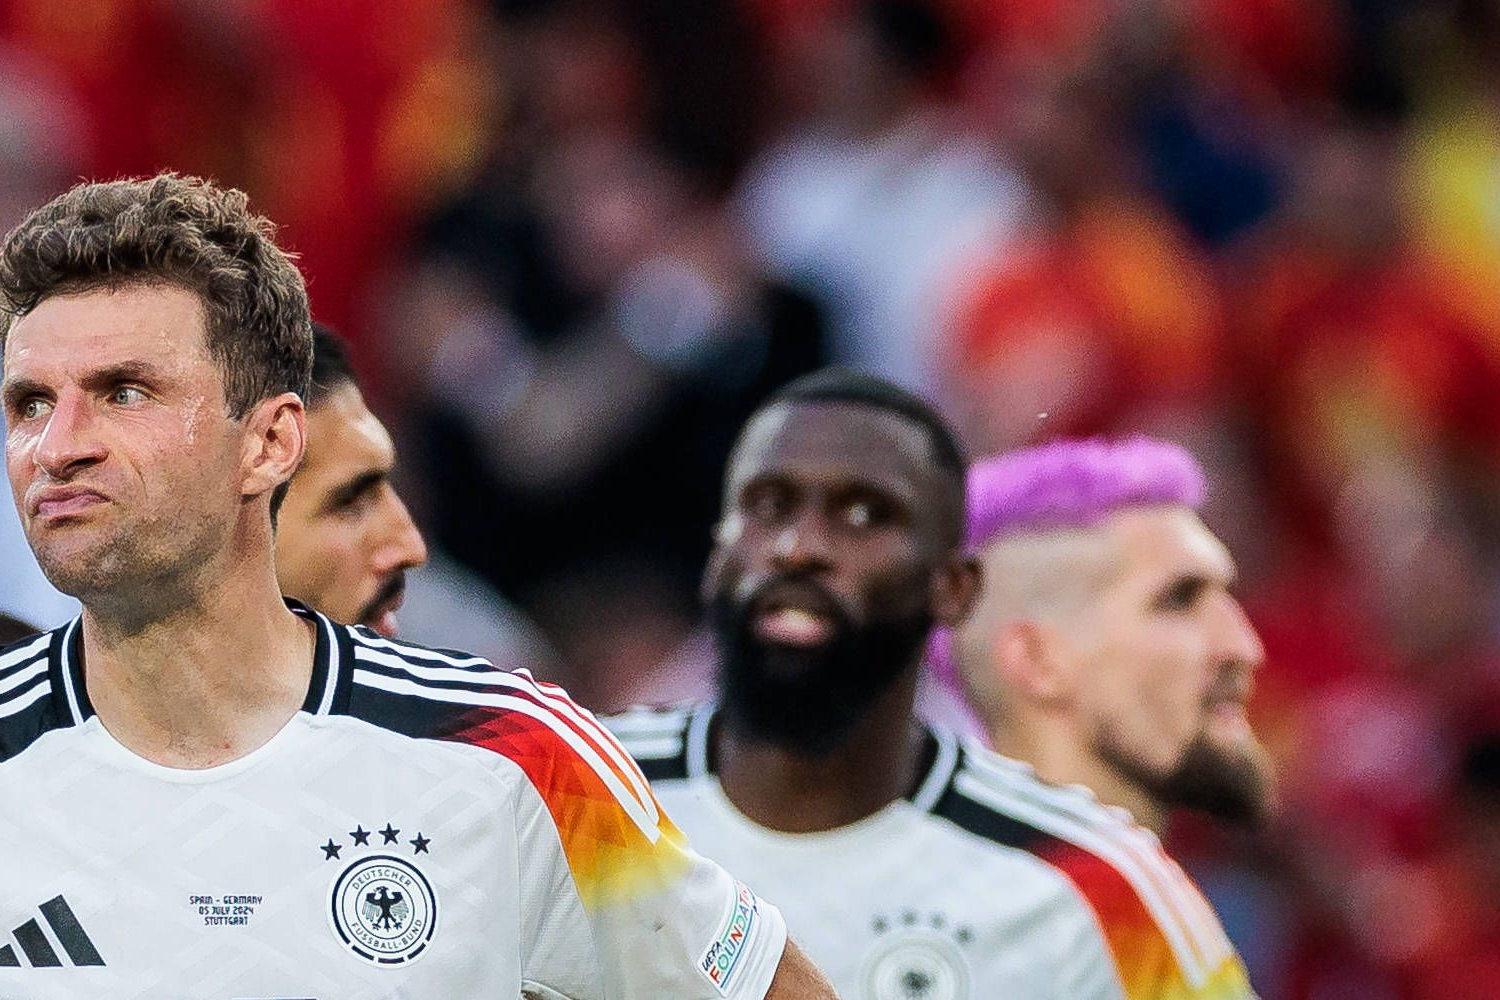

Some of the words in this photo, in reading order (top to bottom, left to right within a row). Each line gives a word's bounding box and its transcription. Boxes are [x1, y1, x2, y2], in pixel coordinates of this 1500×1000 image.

[352, 868, 412, 891] DEUTSCHER
[189, 895, 214, 905] SPAIN
[223, 895, 263, 905] GERMANY
[198, 906, 210, 915] 05
[212, 906, 230, 915] JULY
[233, 906, 254, 915] 2024
[204, 916, 248, 926] STUTTGART
[708, 887, 752, 985] FOUNDAT
